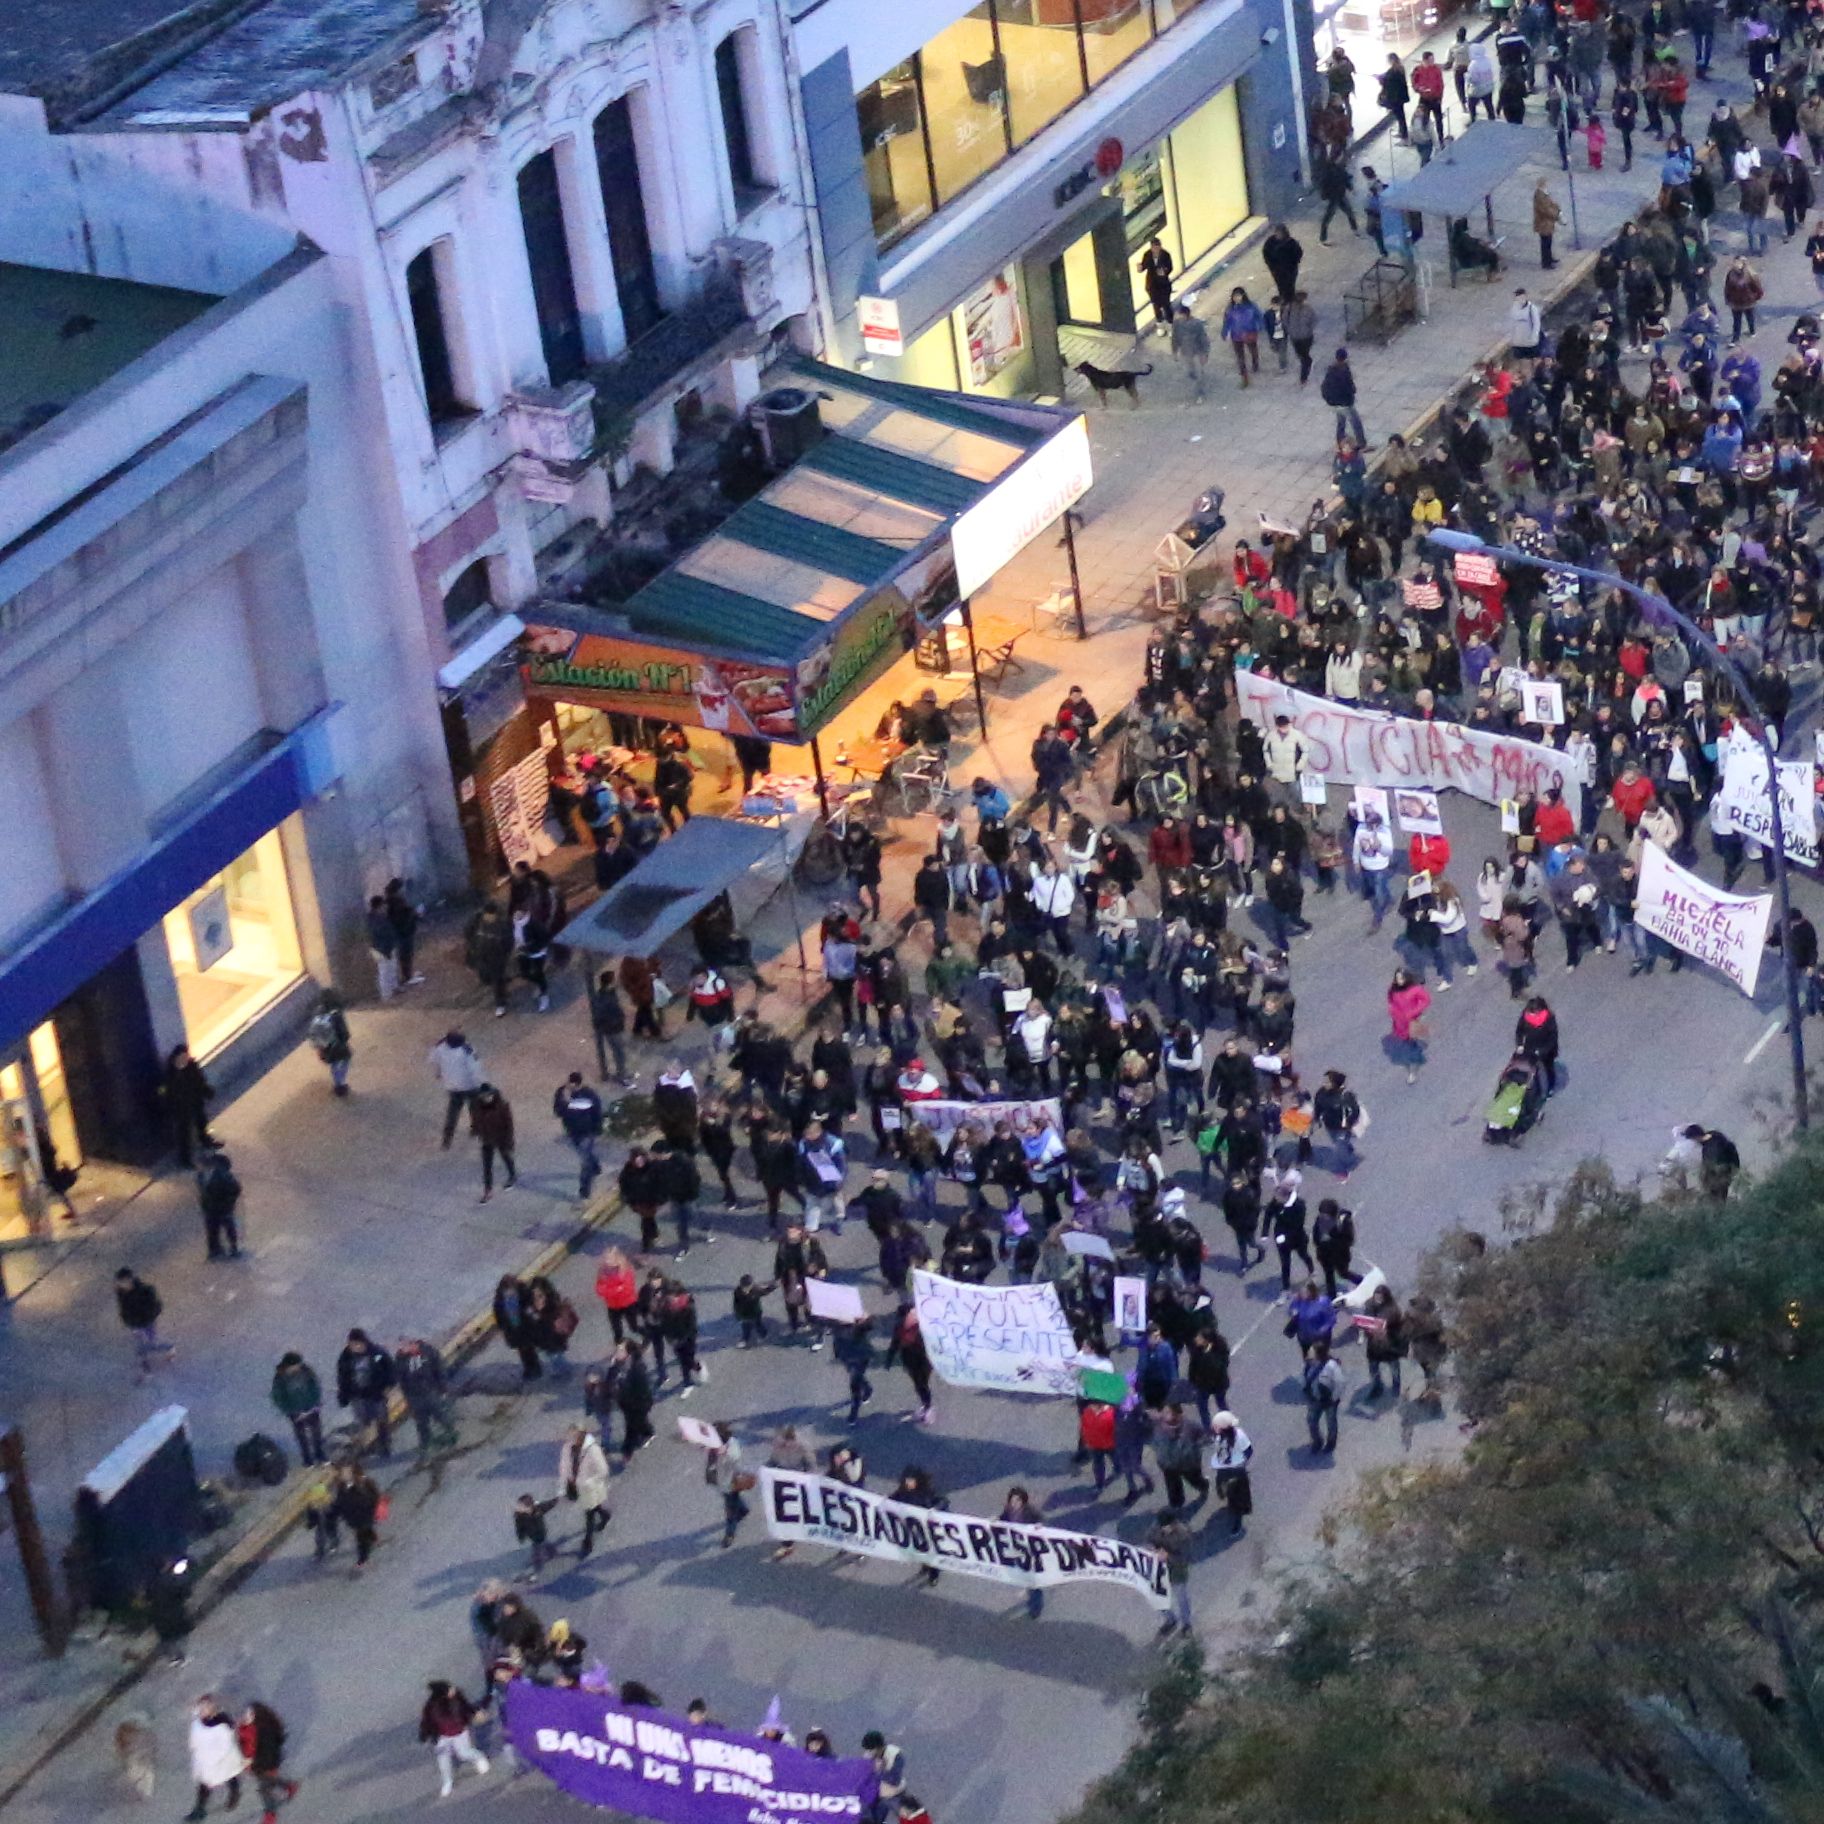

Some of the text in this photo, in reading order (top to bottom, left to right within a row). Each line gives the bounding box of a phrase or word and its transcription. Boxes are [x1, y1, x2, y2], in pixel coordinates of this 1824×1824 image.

[1248, 694, 1452, 777] JSTICIA
[1663, 889, 1745, 950] MICAELA
[774, 1480, 820, 1524] EL
[821, 1487, 929, 1554] ESTADO
[928, 1520, 967, 1559] ES
[536, 1727, 634, 1771] BASTA
[643, 1757, 681, 1786] DE
[606, 1712, 774, 1785] NI UNA MENOS
